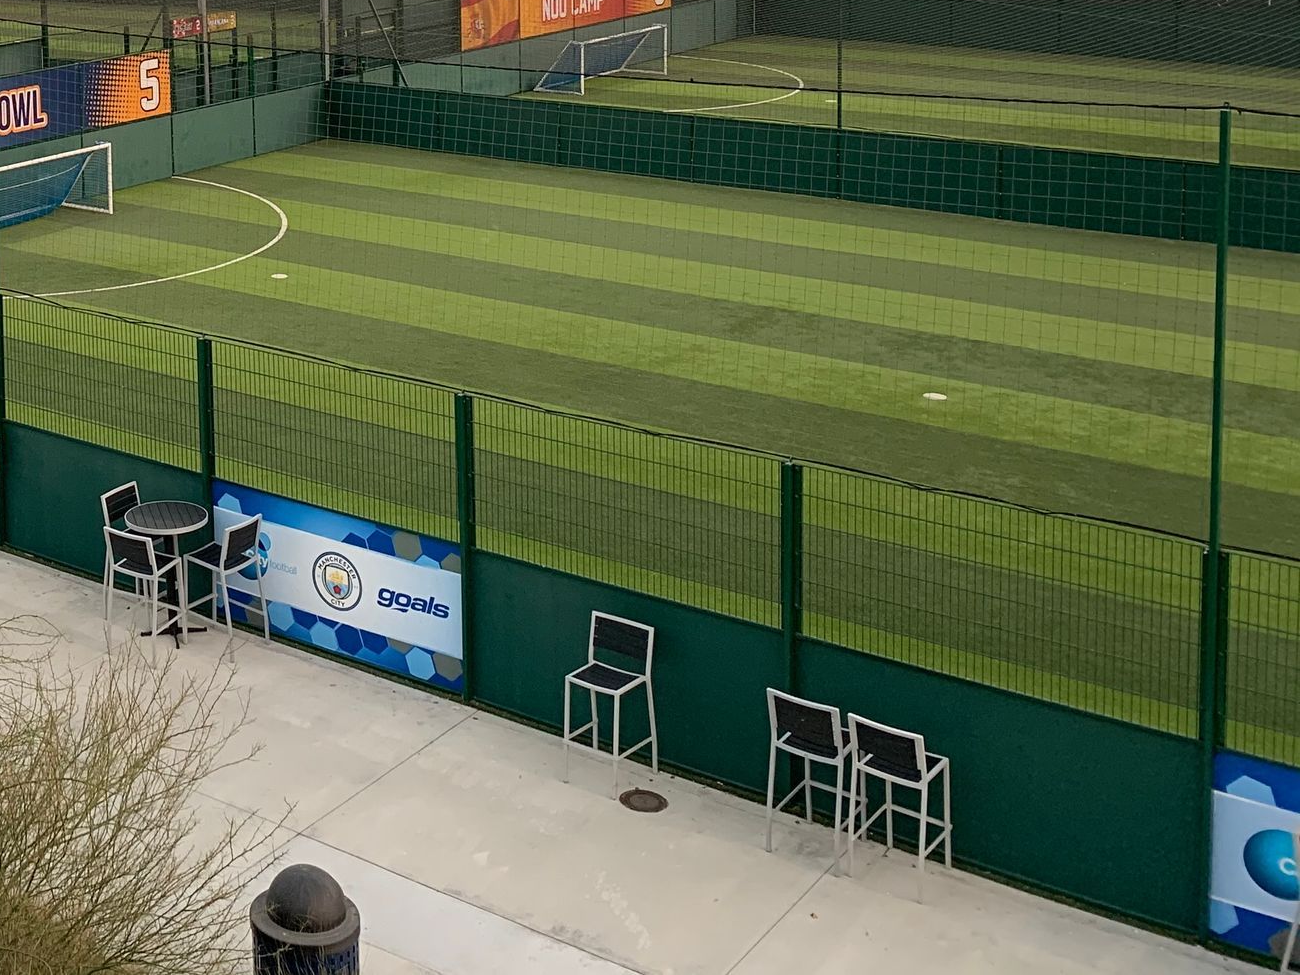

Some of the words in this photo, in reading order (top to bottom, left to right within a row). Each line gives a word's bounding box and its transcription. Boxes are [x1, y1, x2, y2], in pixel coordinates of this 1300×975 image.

[140, 58, 161, 112] 5
[317, 556, 357, 579] MANCHESTER
[330, 598, 345, 607] CITY
[377, 587, 450, 620] goals
